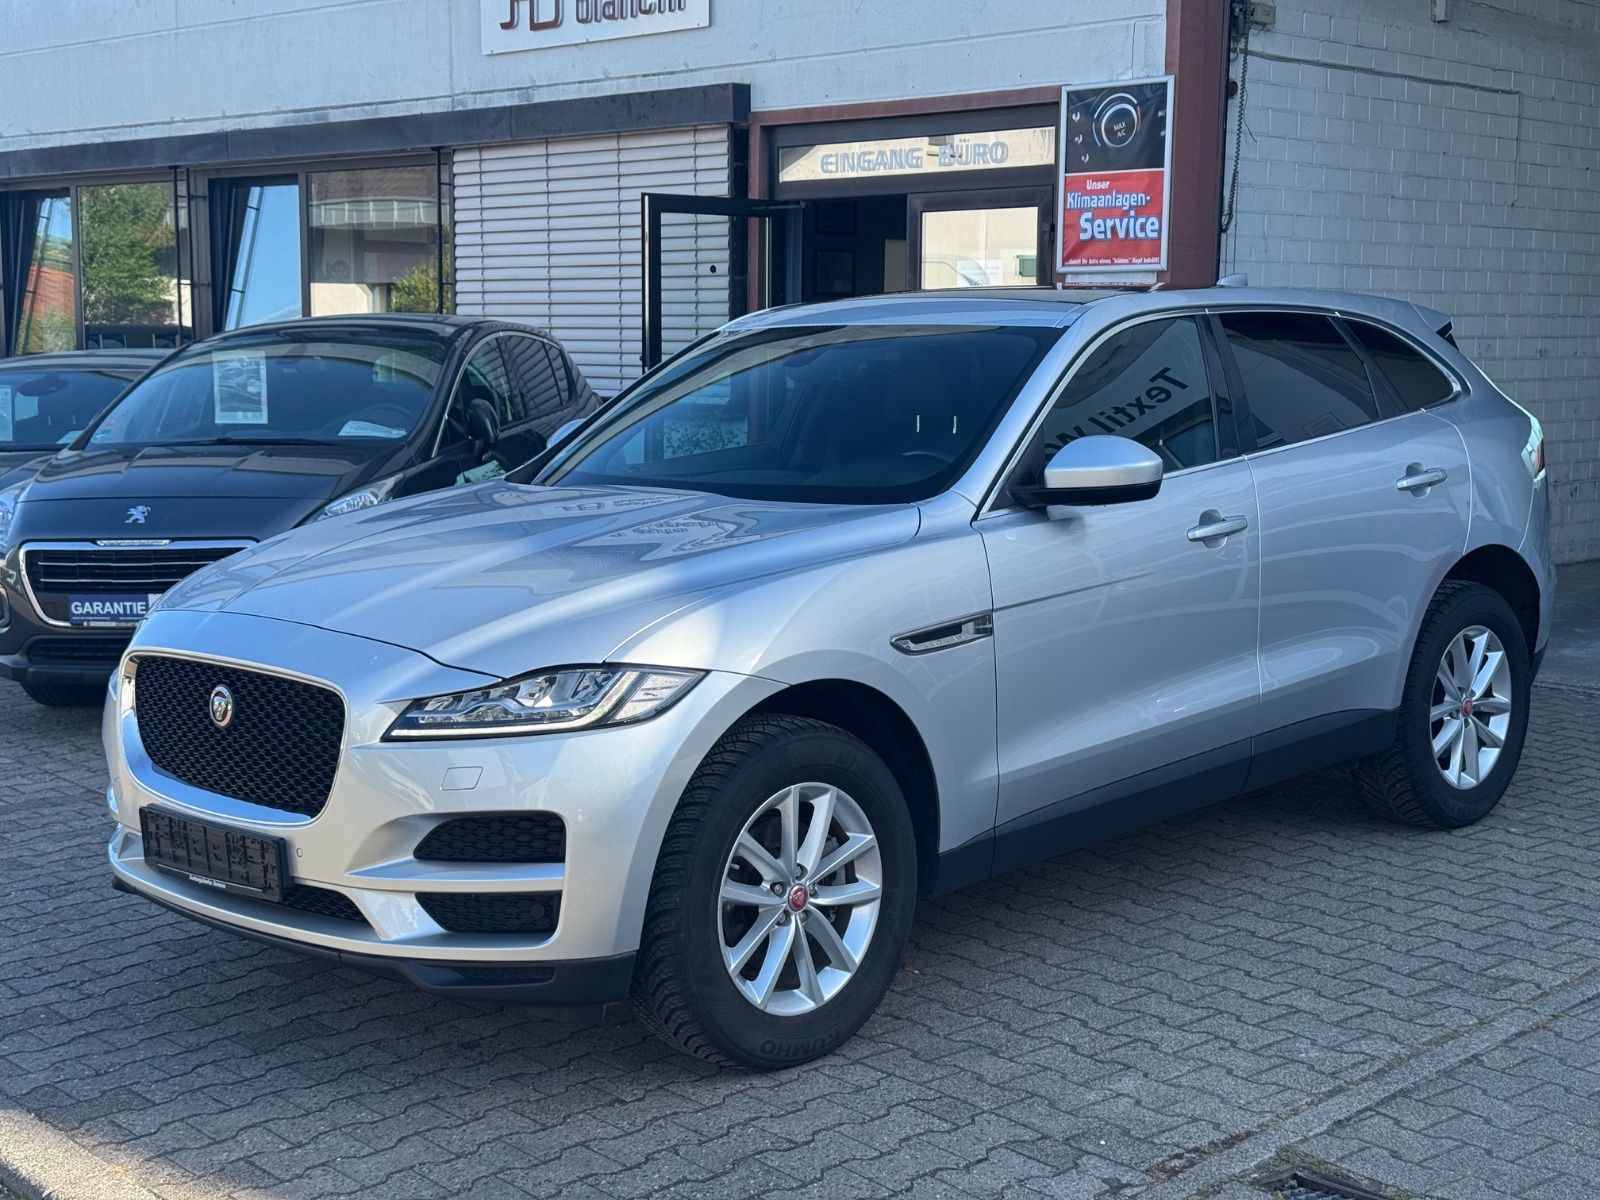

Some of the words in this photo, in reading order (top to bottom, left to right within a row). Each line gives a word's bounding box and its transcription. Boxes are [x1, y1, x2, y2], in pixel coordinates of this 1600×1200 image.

[1113, 121, 1126, 131] MAX
[820, 146, 923, 174] EINGANG
[938, 138, 1009, 167] BÜRO
[1086, 179, 1110, 190] Unser
[1067, 190, 1151, 210] Klimaanlagen-
[1079, 210, 1159, 240] Service
[71, 601, 147, 615] GARANTIE
[760, 1027, 841, 1057] KUMHO
